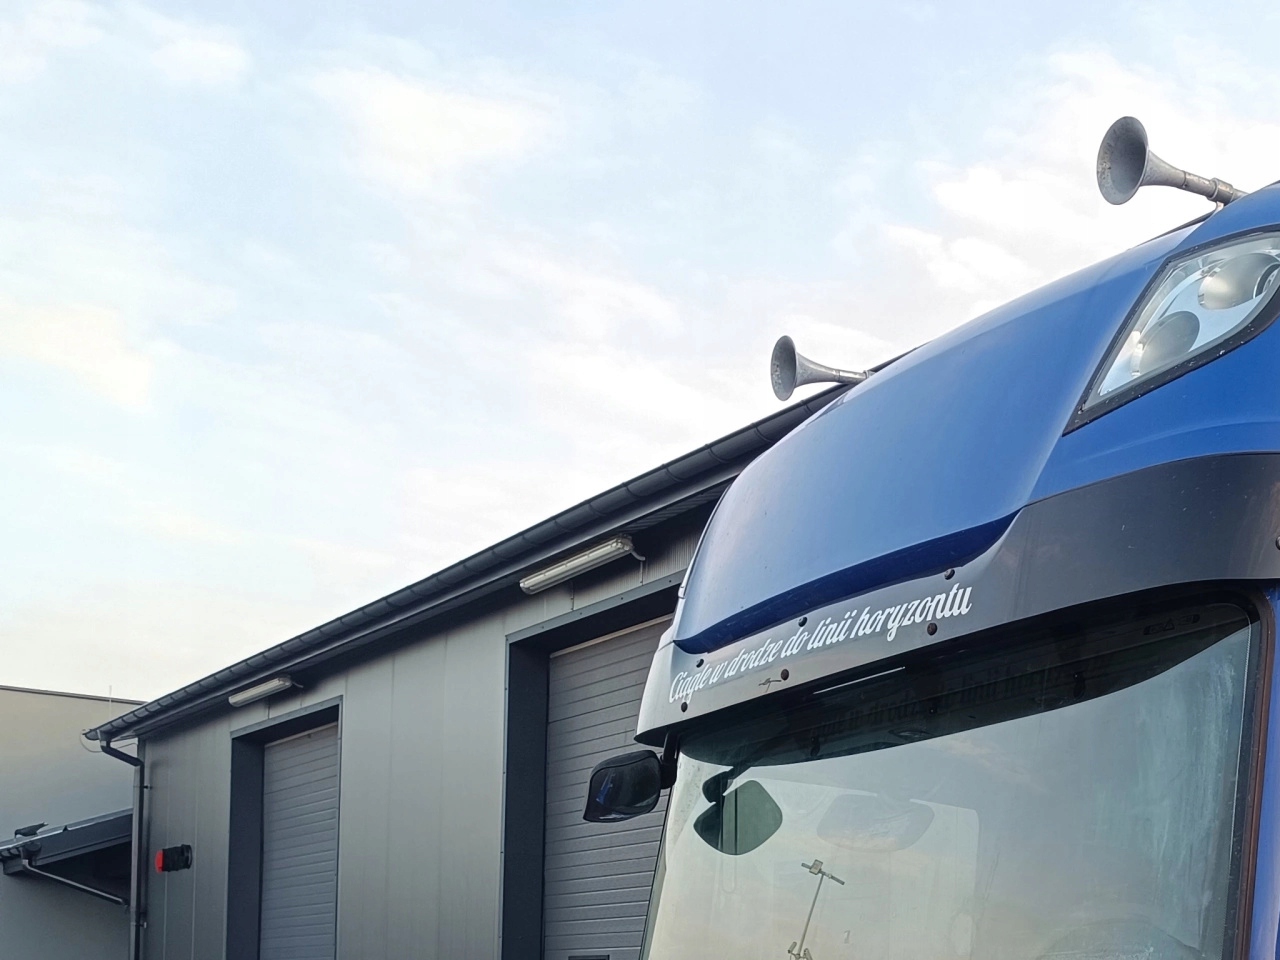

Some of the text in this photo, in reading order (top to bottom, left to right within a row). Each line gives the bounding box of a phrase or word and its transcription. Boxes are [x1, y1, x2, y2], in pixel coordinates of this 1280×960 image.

[709, 661, 727, 685] w
[724, 635, 782, 679] drodze
[780, 626, 811, 659] do
[806, 609, 858, 651] linii
[849, 583, 973, 642] horyzontu
